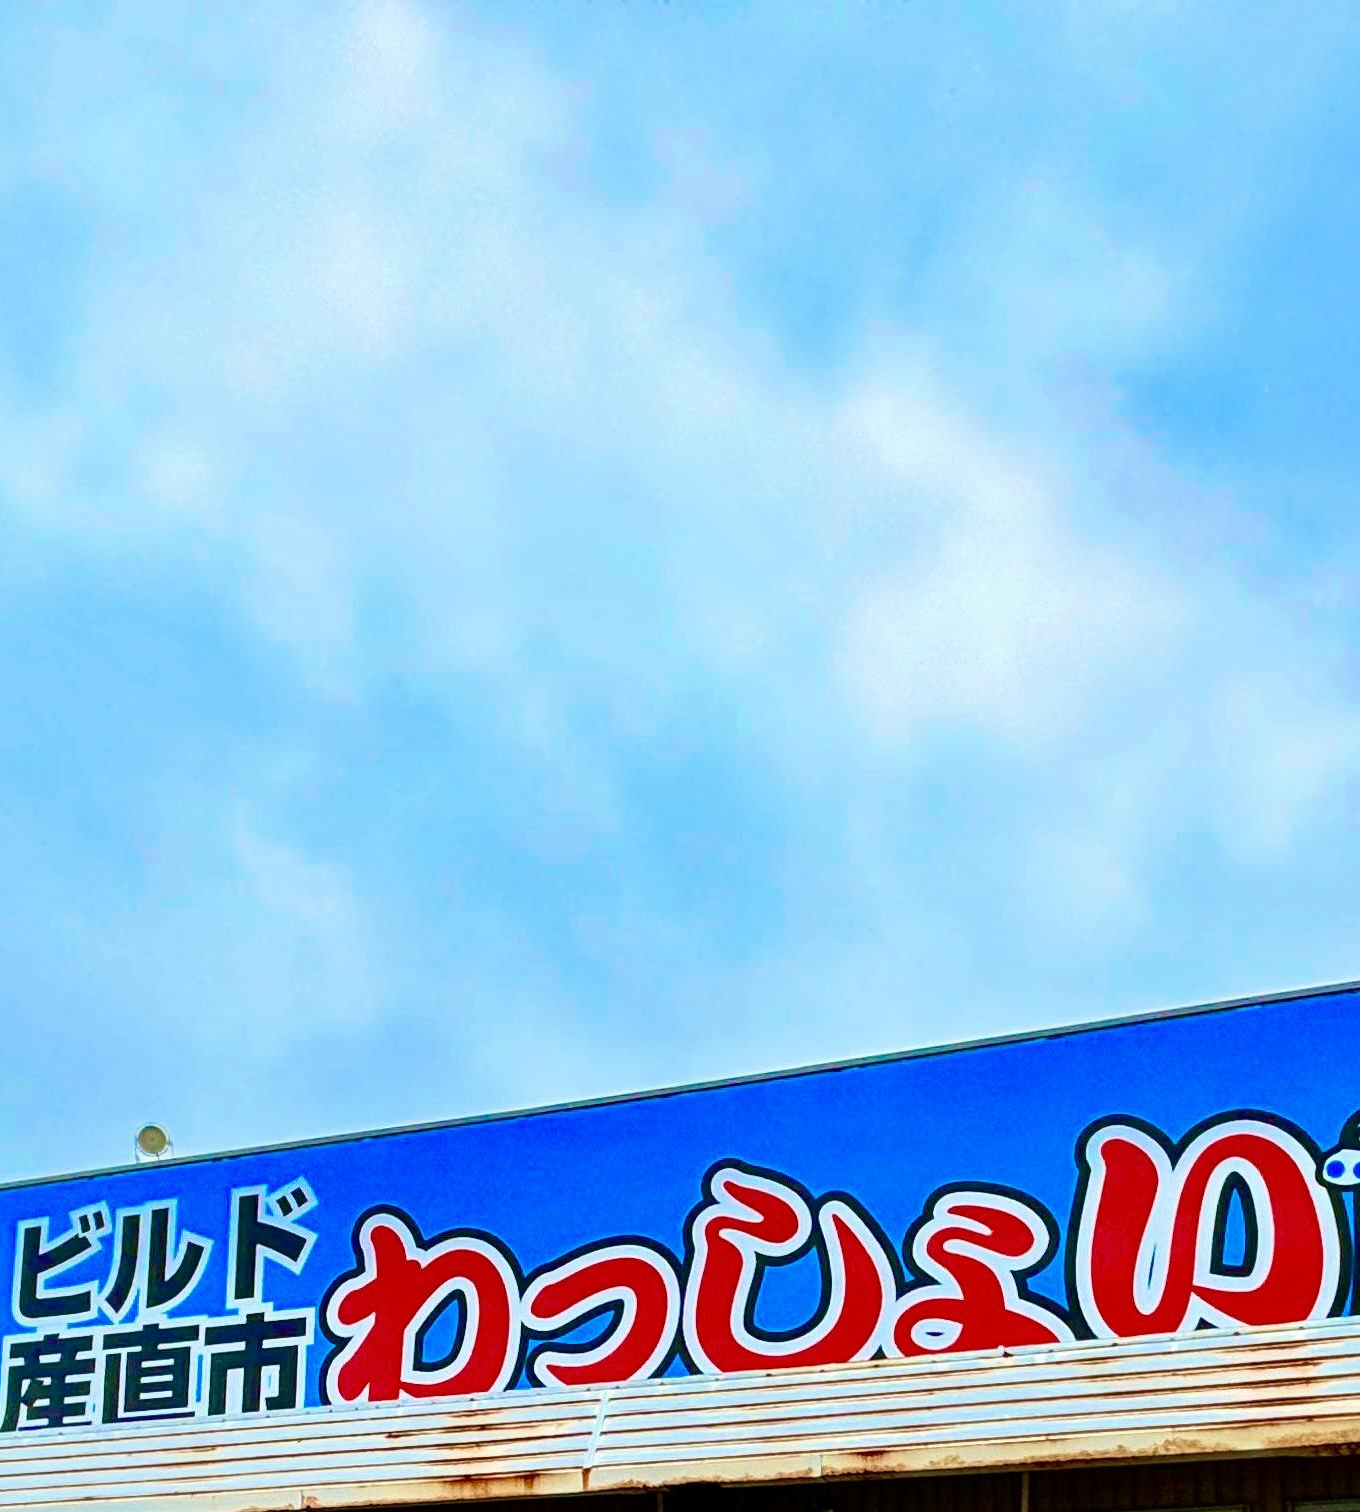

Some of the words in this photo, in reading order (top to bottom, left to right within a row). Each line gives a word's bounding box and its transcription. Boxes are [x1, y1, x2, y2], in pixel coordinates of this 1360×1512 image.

[13, 1177, 319, 1323] ビルド
[0, 1314, 315, 1432] 産直市
